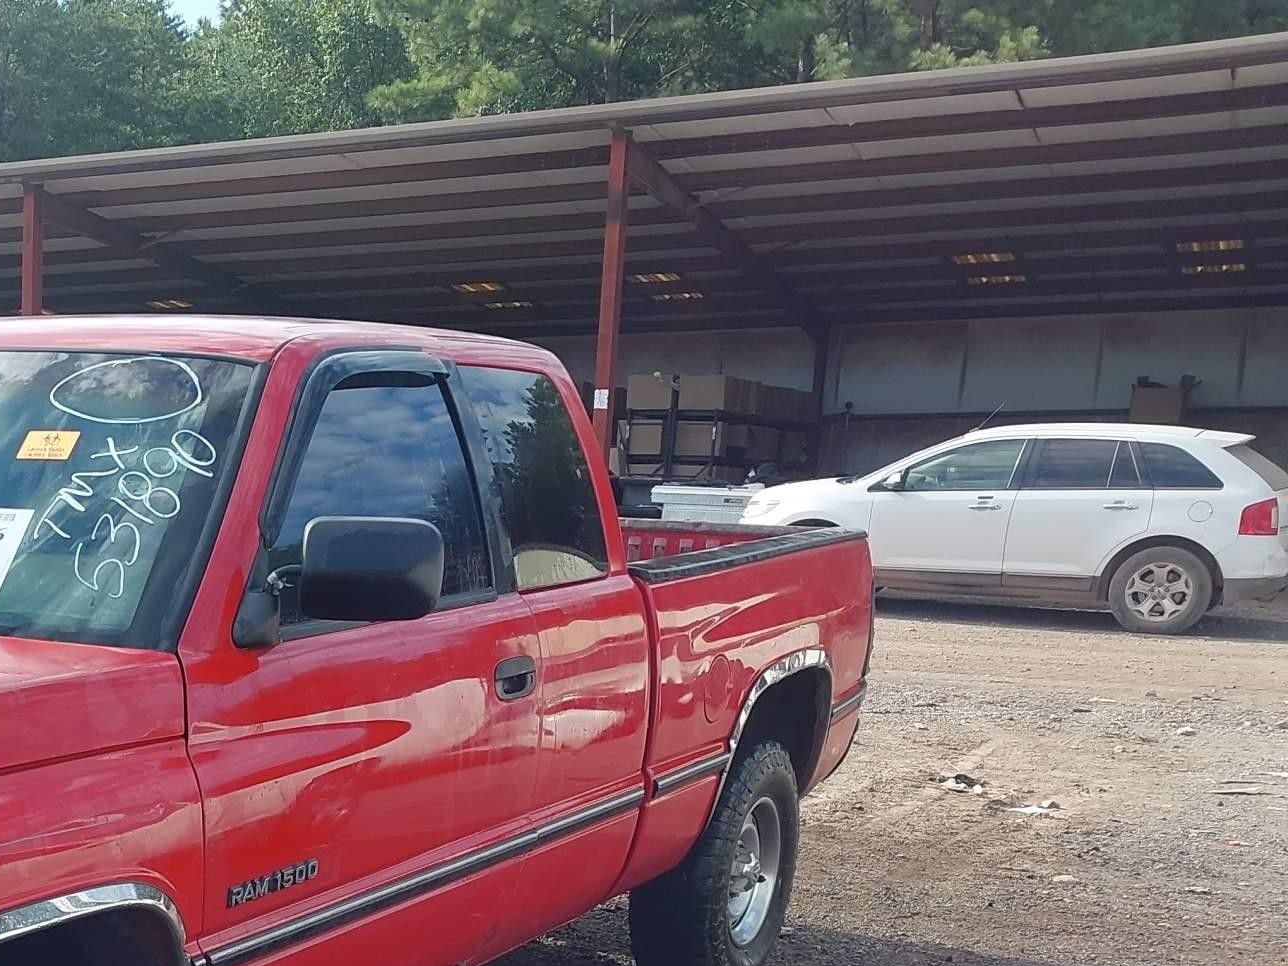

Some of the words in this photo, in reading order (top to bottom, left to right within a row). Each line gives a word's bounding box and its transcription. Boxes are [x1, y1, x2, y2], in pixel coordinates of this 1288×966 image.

[74, 429, 217, 599] 531890
[228, 876, 270, 907] RAM
[274, 858, 320, 890] 1500
